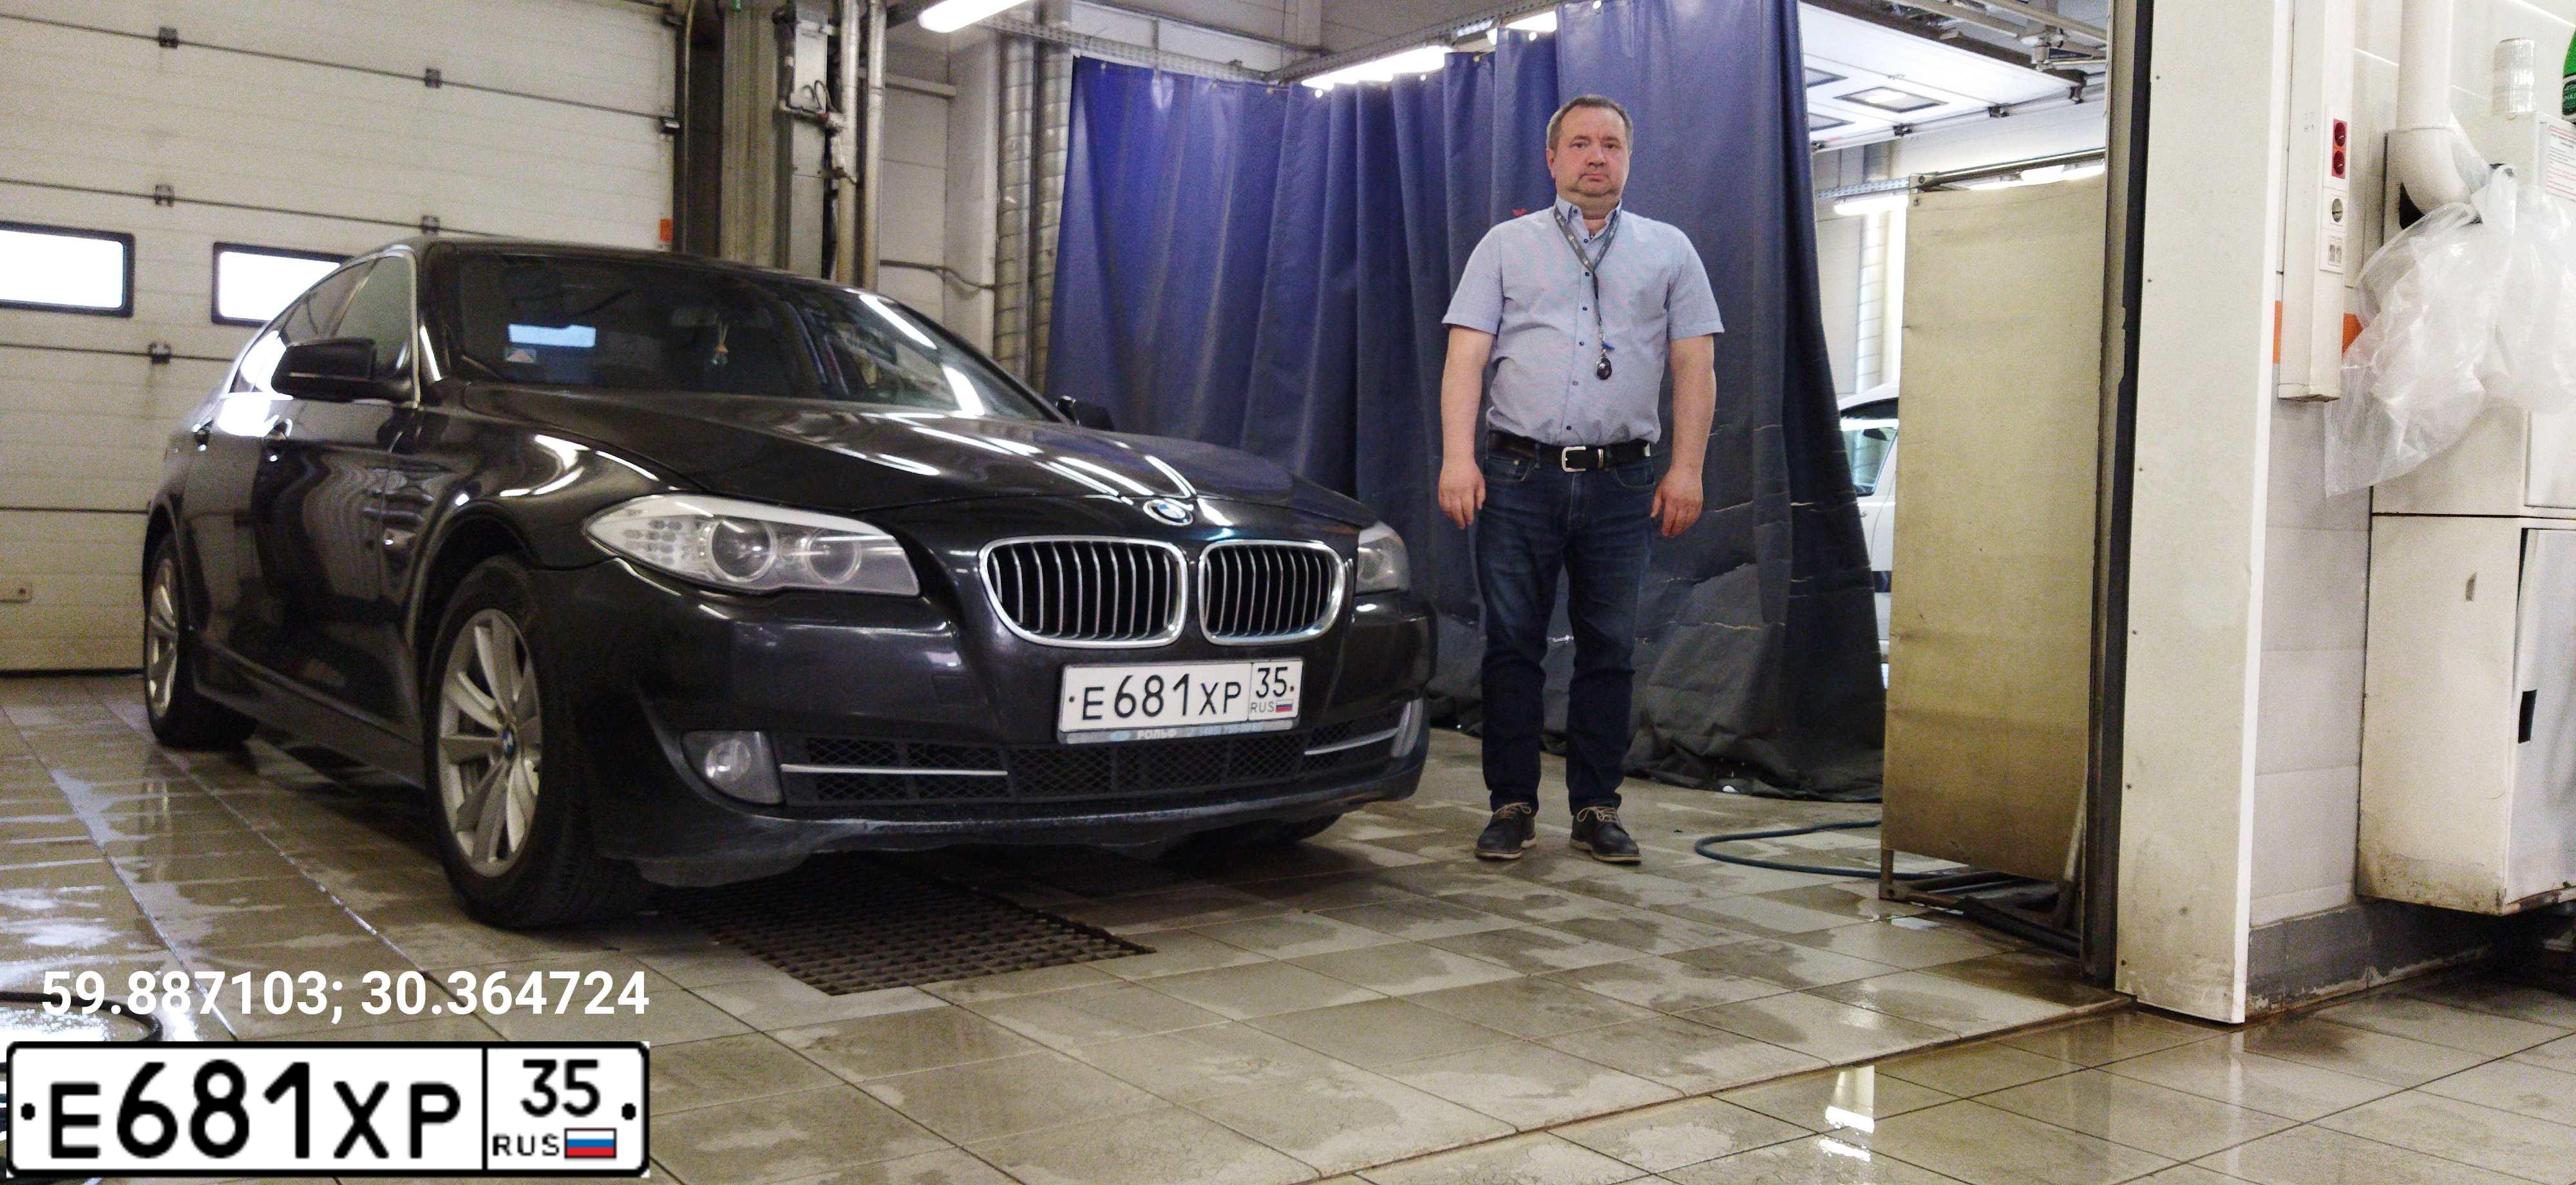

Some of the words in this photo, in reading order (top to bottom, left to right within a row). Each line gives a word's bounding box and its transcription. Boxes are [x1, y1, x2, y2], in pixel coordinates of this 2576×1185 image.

[1082, 674, 1242, 721] Е681ХР
[1255, 666, 1289, 699] 35
[1249, 701, 1275, 714] RUS
